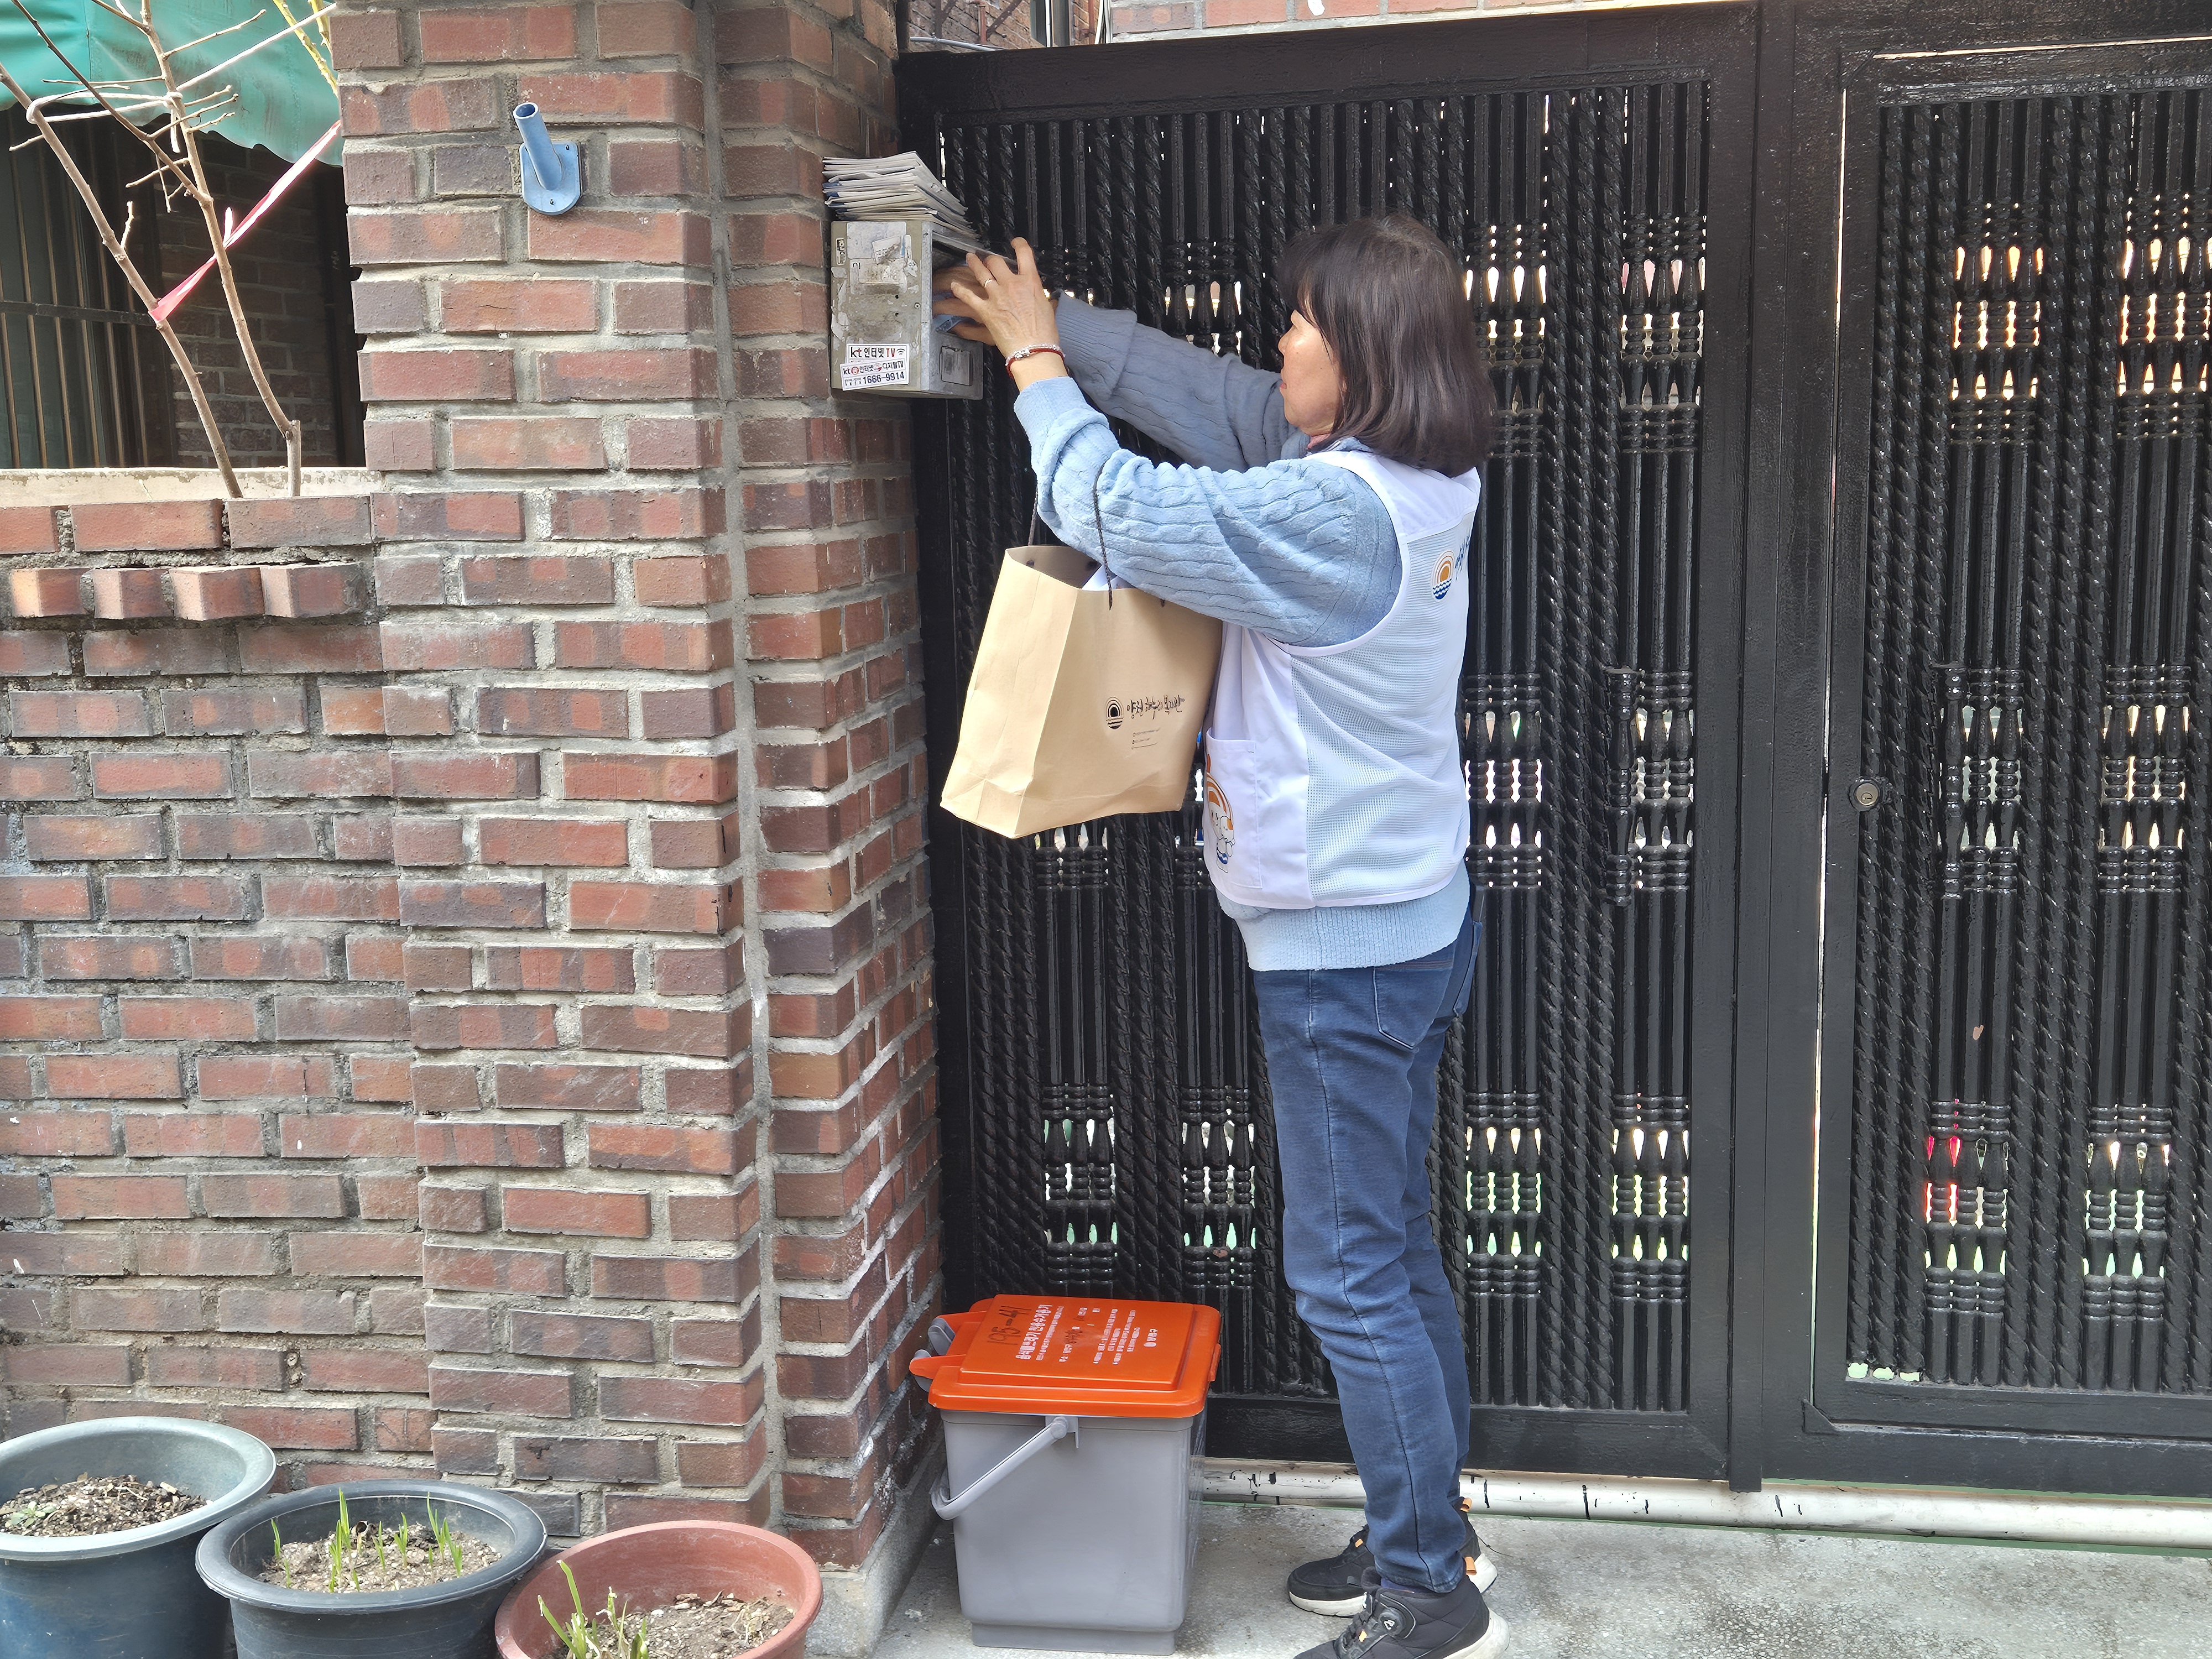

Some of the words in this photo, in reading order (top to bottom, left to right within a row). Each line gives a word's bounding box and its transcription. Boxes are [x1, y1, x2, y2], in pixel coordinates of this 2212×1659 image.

[851, 347, 862, 358] kt
[864, 347, 884, 358] 인터넷
[886, 348, 895, 357] TV
